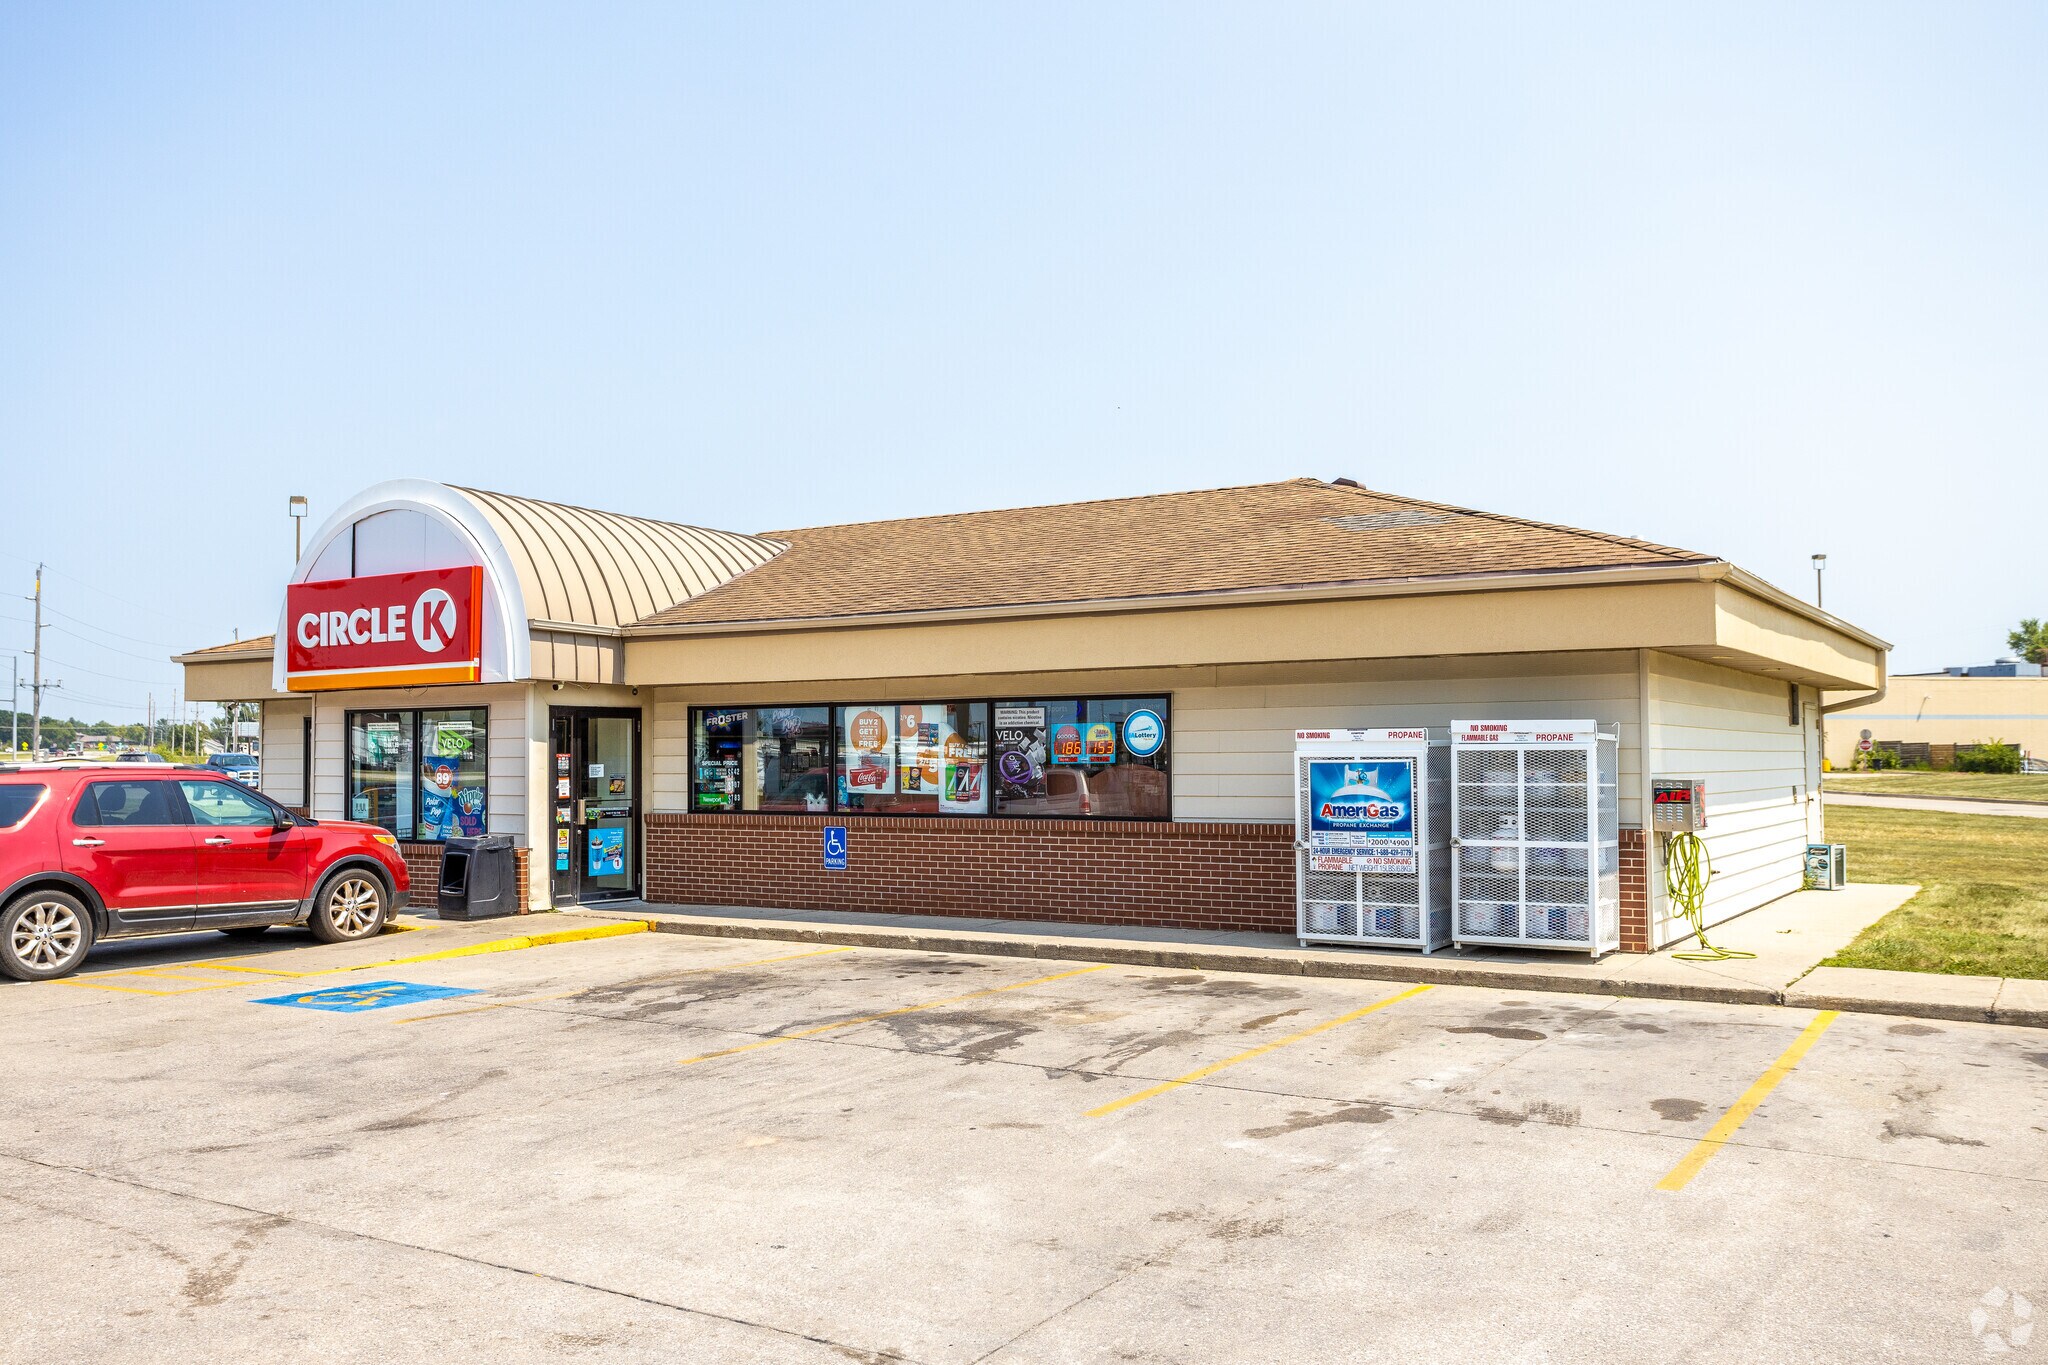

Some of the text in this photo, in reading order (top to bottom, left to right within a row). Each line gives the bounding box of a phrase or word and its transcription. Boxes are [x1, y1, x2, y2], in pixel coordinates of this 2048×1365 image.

[297, 605, 406, 649] CIRCLE
[706, 711, 748, 727] FROSTER
[1480, 724, 1508, 732] SMOKING
[995, 730, 1023, 741] VELO
[1387, 731, 1423, 739] PROPANE
[1535, 733, 1574, 741] PROPANE
[442, 738, 464, 748] VELO
[1061, 741, 1081, 754] 186
[1093, 741, 1114, 754] 153
[425, 797, 440, 806] Polar
[1654, 789, 1692, 804] AIR
[430, 806, 442, 818] Pop
[1320, 803, 1400, 818] AmeriGas
[460, 815, 477, 826] SOLD
[825, 857, 845, 865] PARKING
[1317, 856, 1353, 864] FLAMMABLE
[1317, 863, 1343, 871] PROPANE
